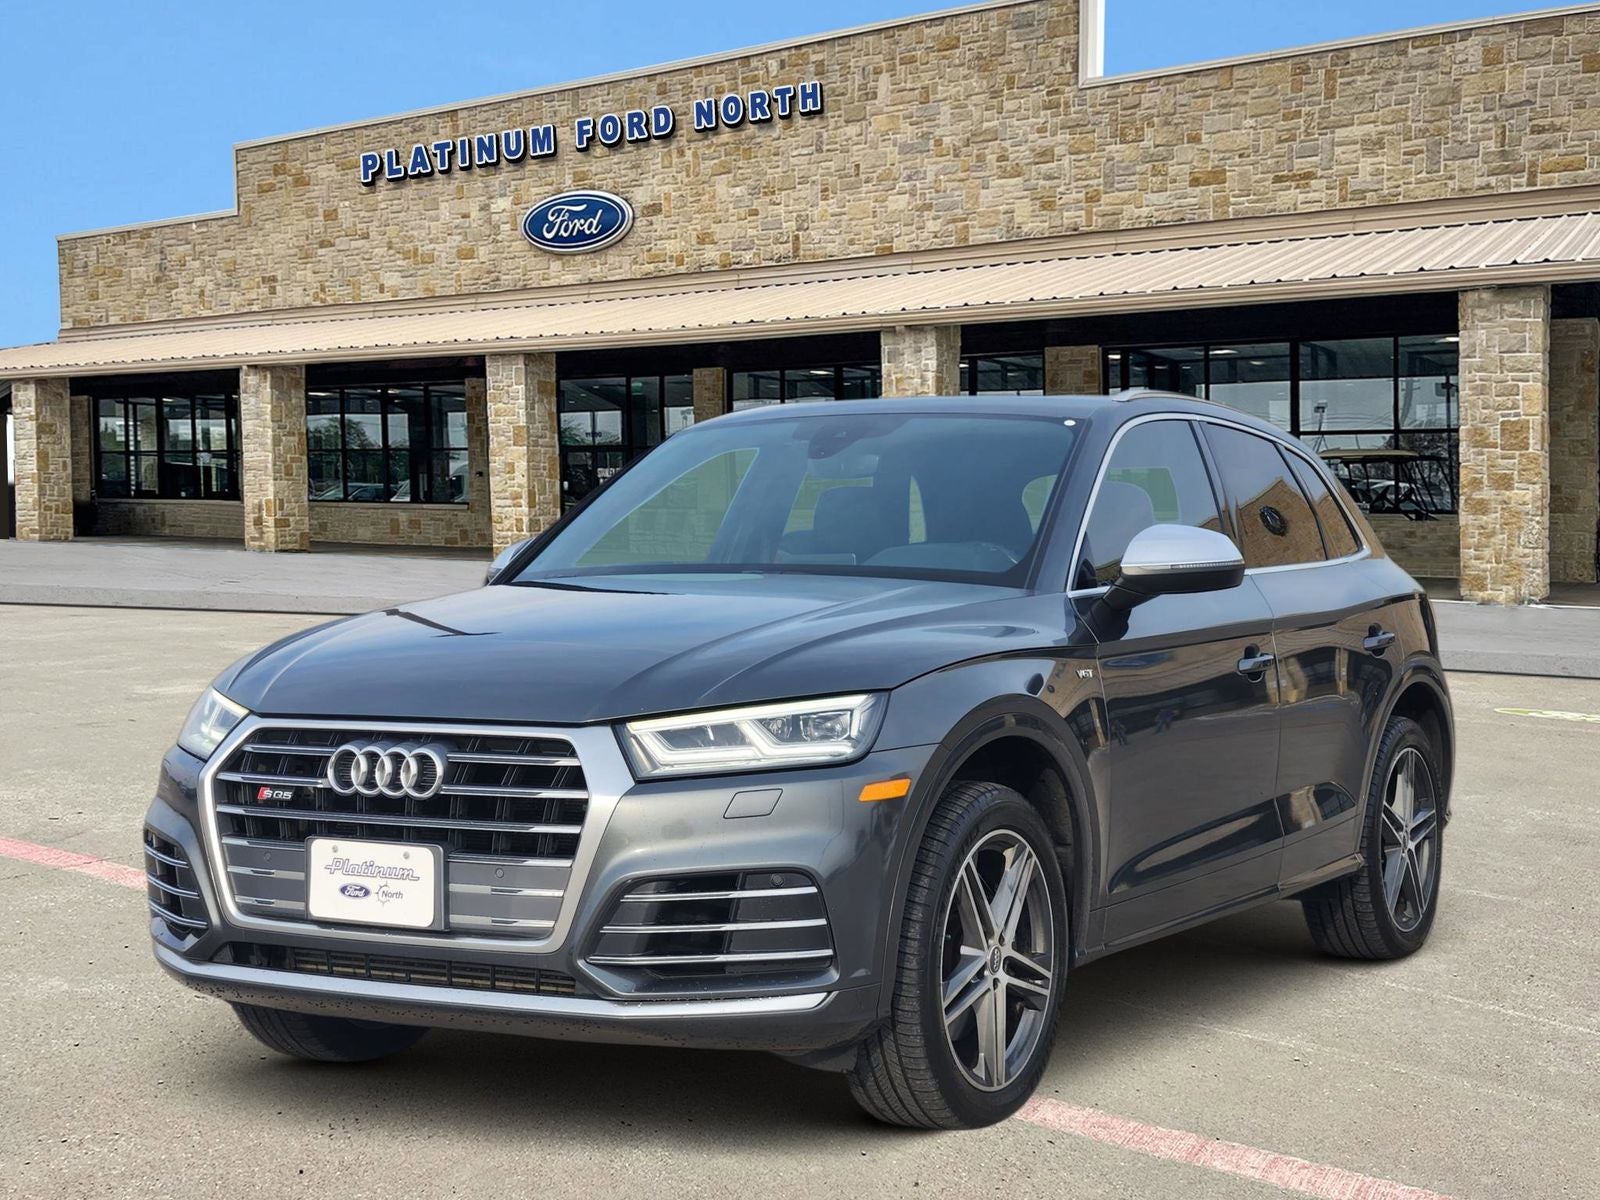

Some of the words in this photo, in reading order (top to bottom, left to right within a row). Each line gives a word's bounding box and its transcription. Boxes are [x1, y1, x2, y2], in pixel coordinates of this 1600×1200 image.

[360, 123, 556, 186] PLATINUM
[575, 105, 674, 152] FORD
[694, 81, 824, 132] NORTH
[543, 203, 603, 239] Ford
[263, 789, 293, 800] SQ5
[325, 857, 420, 881] Platinum
[344, 885, 366, 898] Ford
[381, 889, 404, 899] North
